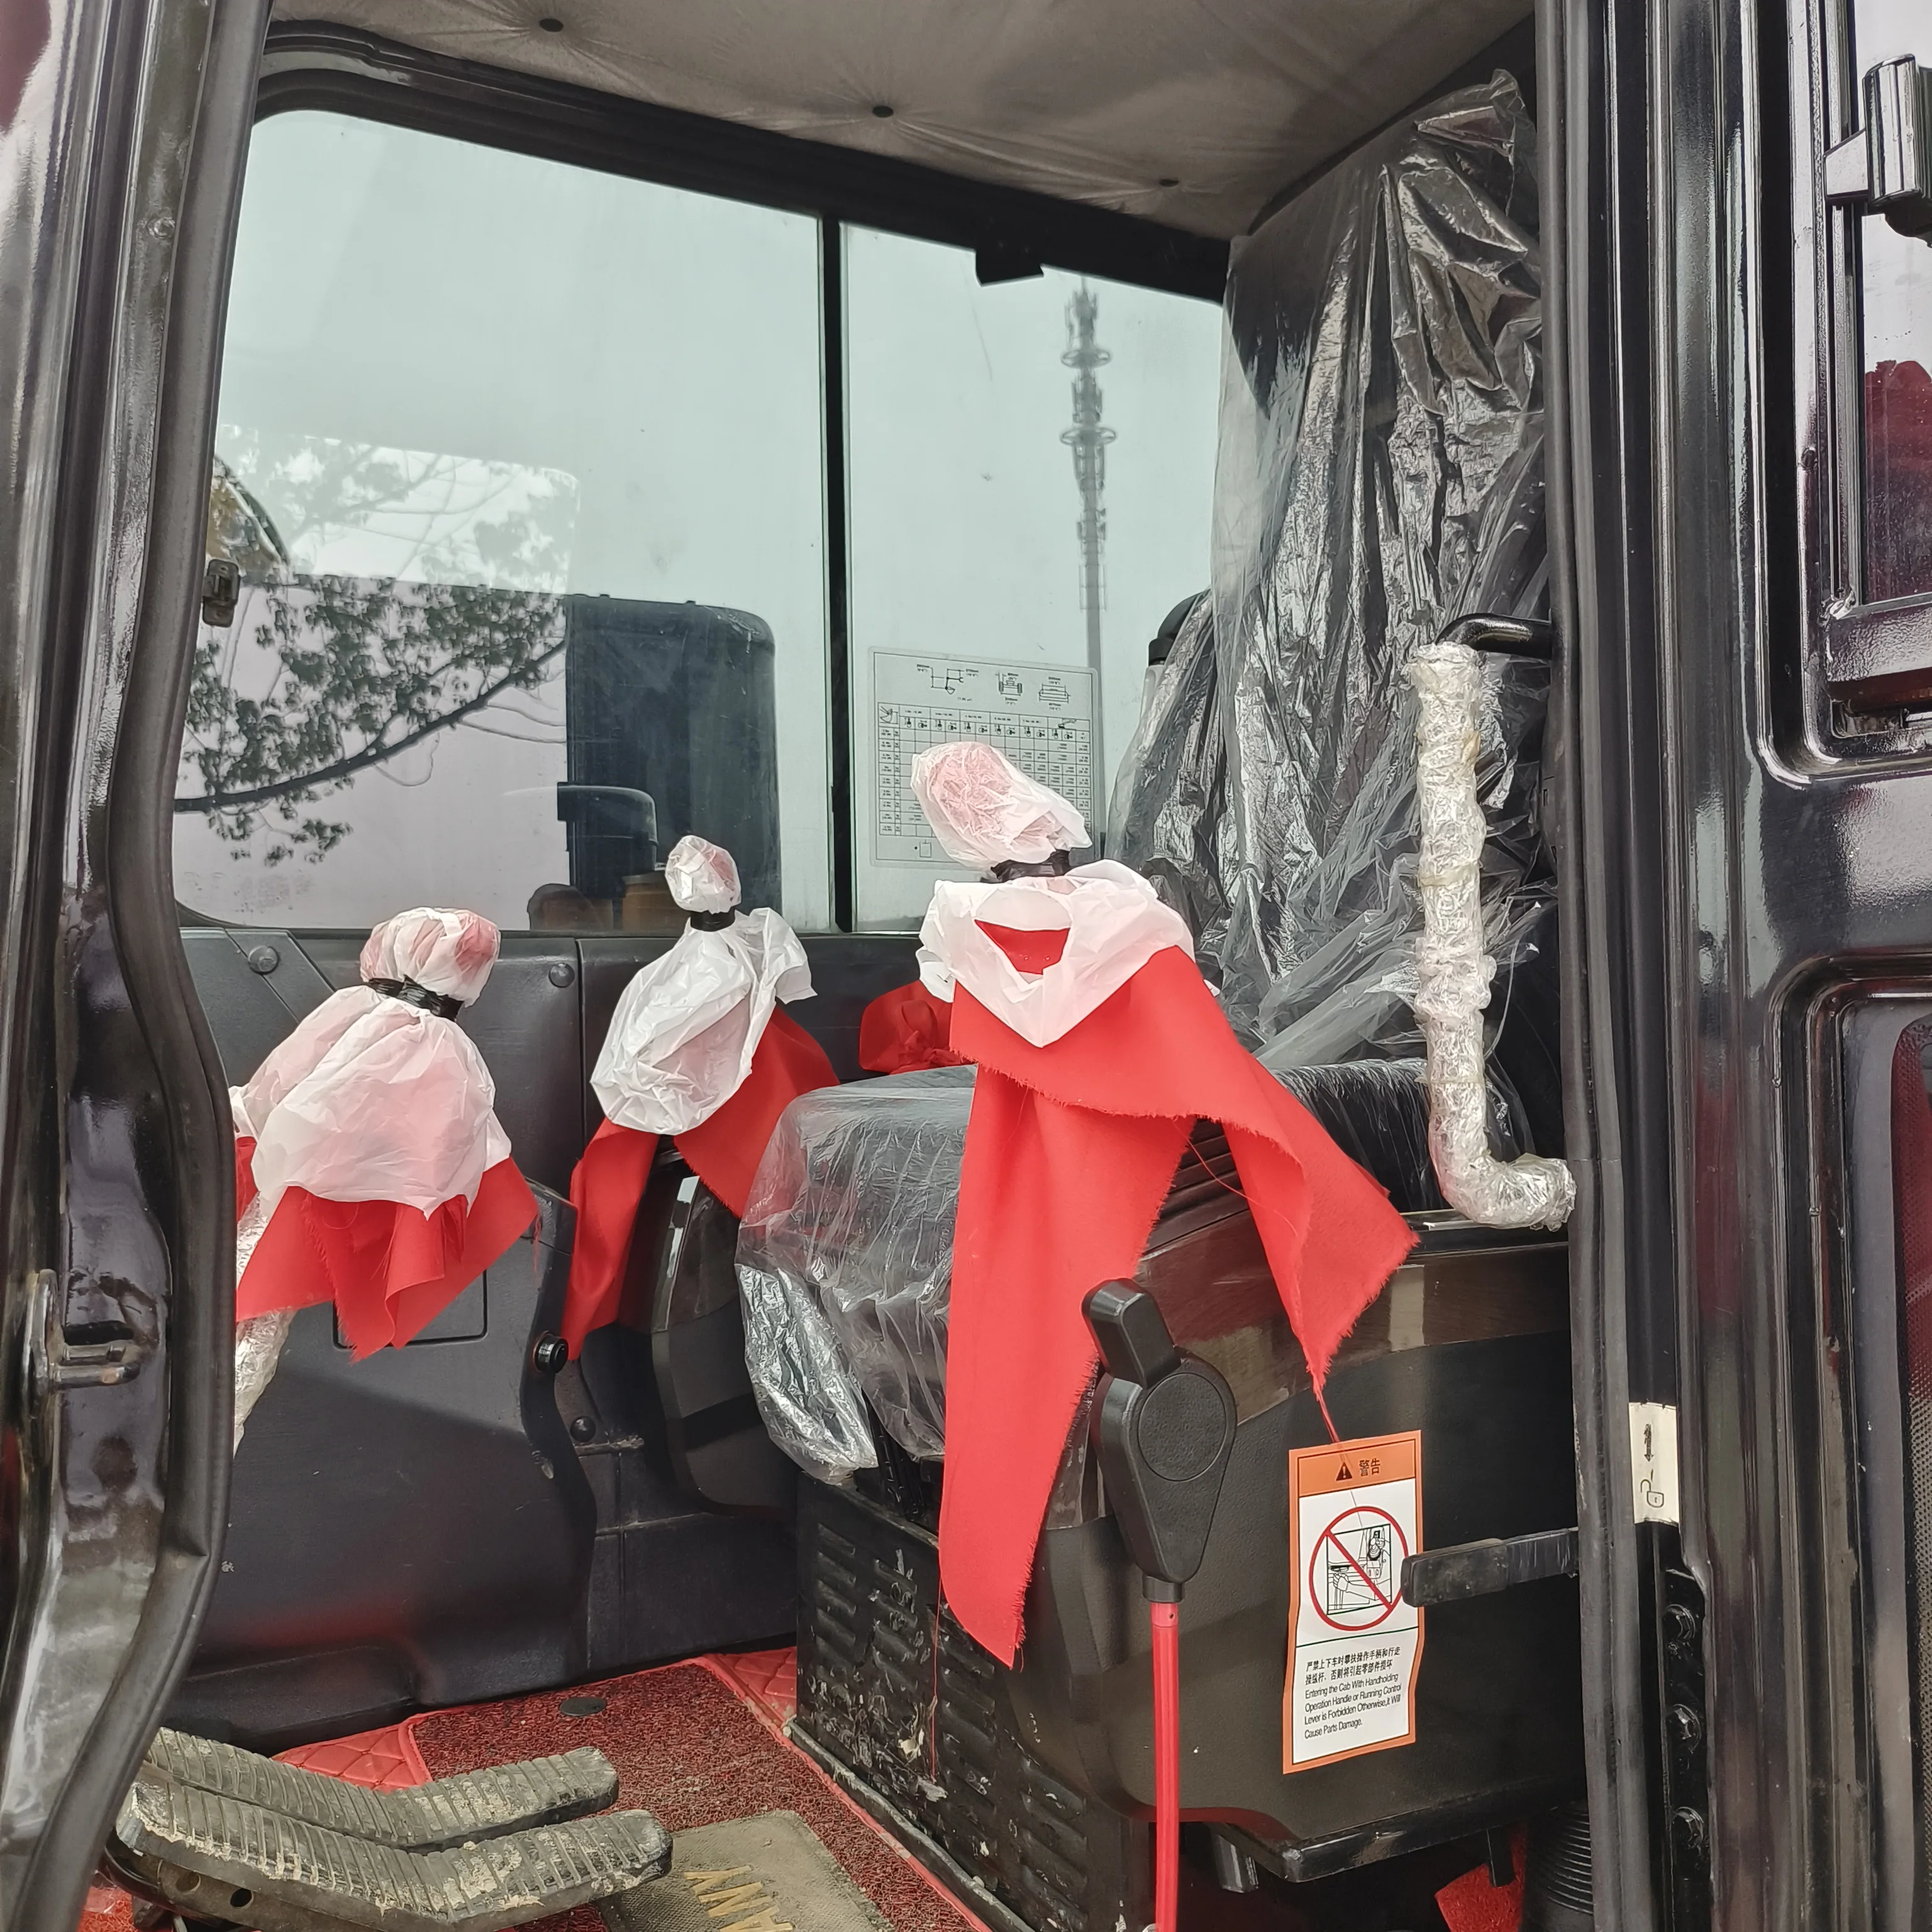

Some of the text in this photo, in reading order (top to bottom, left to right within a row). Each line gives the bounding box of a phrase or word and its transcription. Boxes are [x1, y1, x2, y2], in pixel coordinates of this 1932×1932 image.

[1359, 1458, 1380, 1477] 警告
[1305, 1699, 1331, 1713] Operation
[1332, 1694, 1352, 1705] Handle
[1360, 1689, 1382, 1699] Running
[1384, 1683, 1402, 1695] Control
[1306, 1674, 1399, 1699] Entering the Cab With Handholding
[1304, 1714, 1321, 1725] Lever
[1322, 1711, 1327, 1720] is
[1328, 1706, 1357, 1719] Forbidden
[1391, 1694, 1401, 1704] Will
[1304, 1718, 1363, 1740] Cause Parts Damage.
